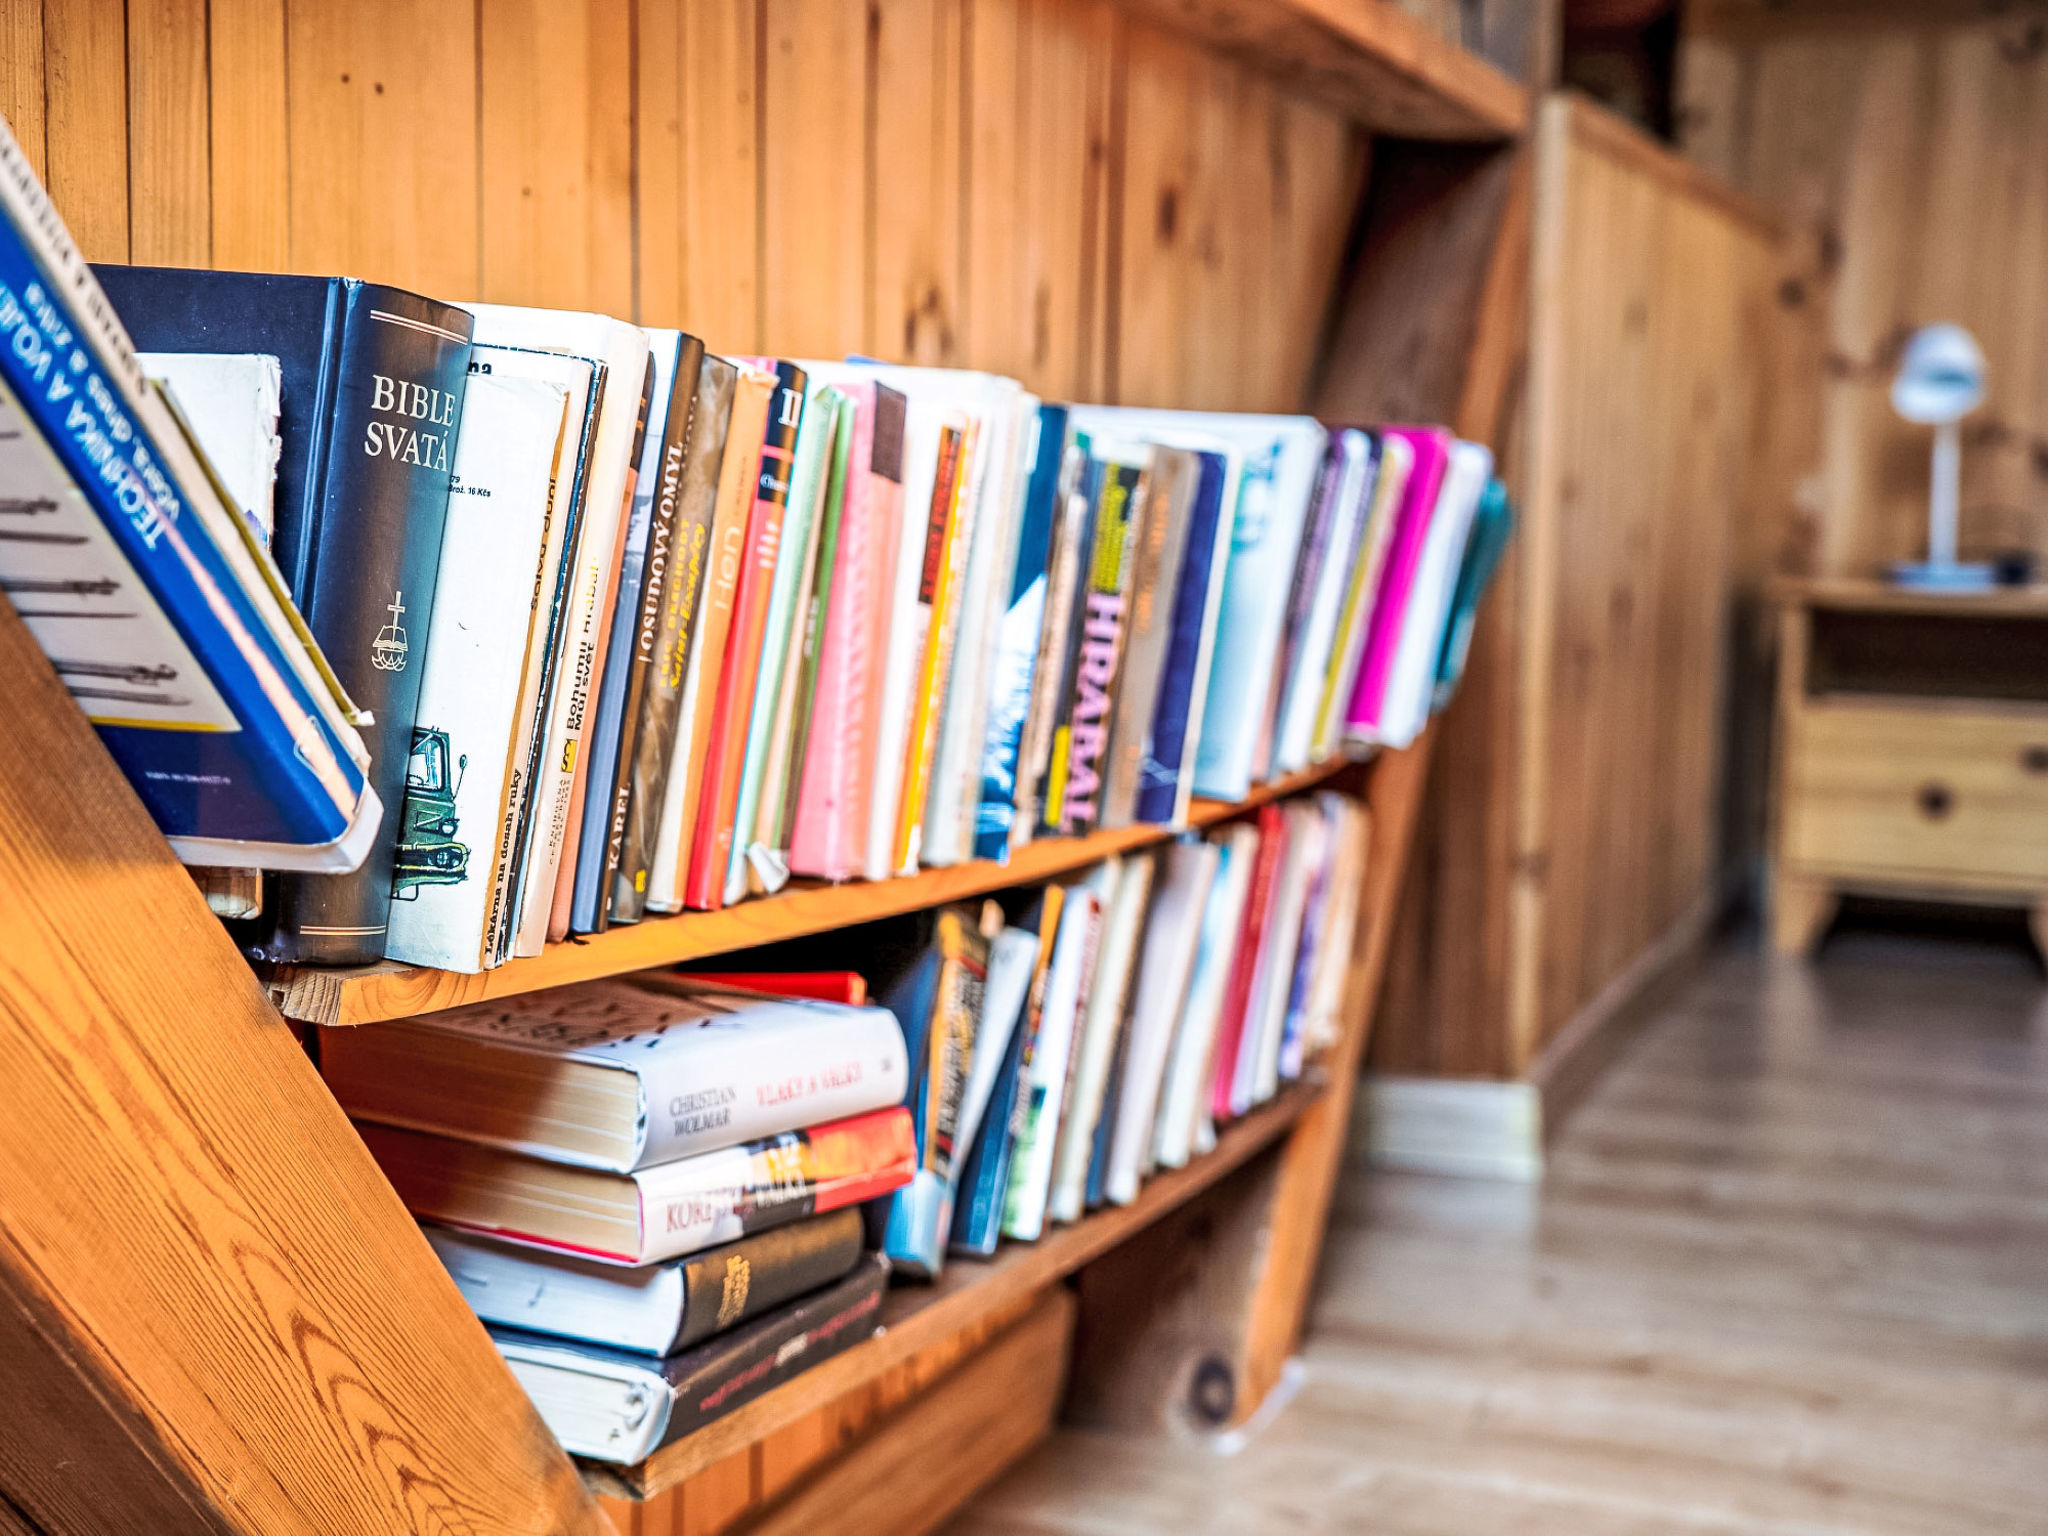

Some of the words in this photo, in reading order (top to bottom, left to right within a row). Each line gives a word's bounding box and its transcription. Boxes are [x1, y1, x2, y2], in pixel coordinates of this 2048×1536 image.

[46, 369, 75, 402] A
[86, 371, 133, 443] dnes
[371, 374, 456, 428] BIBLE
[364, 421, 448, 473] SVATÁ
[65, 399, 166, 552] TECHNIKA
[468, 487, 476, 496] 16
[476, 488, 491, 498] Kčs
[640, 520, 671, 652] OSUDOVÝ
[660, 440, 684, 519] OMYL
[566, 640, 588, 731] Bohumil
[507, 768, 522, 809] ruky
[500, 810, 514, 860] dosah
[608, 781, 632, 871] KAREL
[496, 862, 507, 883] na
[485, 887, 503, 954] Lékárna
[668, 1086, 738, 1119] CHRISTIAN
[674, 1107, 732, 1137] WOLMAR
